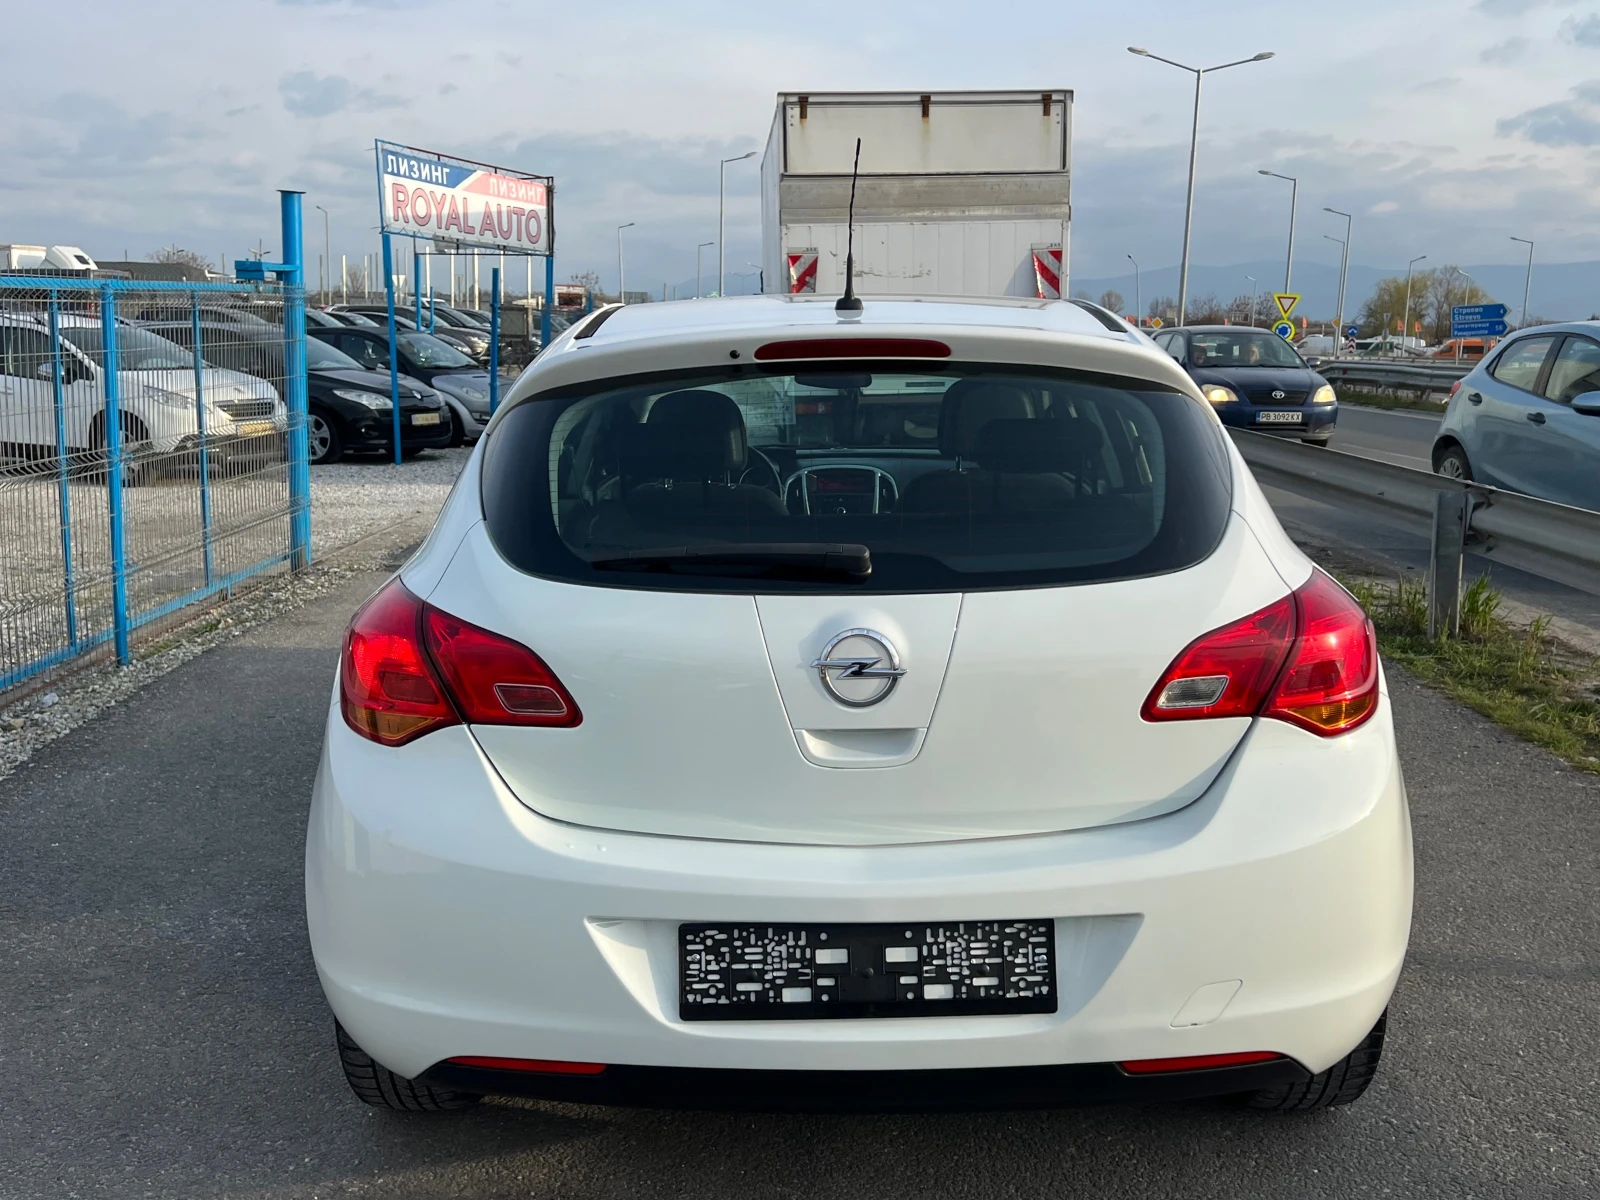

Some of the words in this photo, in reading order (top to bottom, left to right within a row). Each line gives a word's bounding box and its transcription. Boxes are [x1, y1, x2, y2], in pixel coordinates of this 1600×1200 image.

[387, 154, 450, 185] ЛИЗИНГ
[489, 177, 544, 203] ЛИЗИНГ
[392, 182, 475, 235] ROYAL
[479, 201, 542, 245] AUTO
[1261, 412, 1271, 421] PB
[1272, 412, 1290, 421] 3092
[1290, 412, 1301, 421] KX
